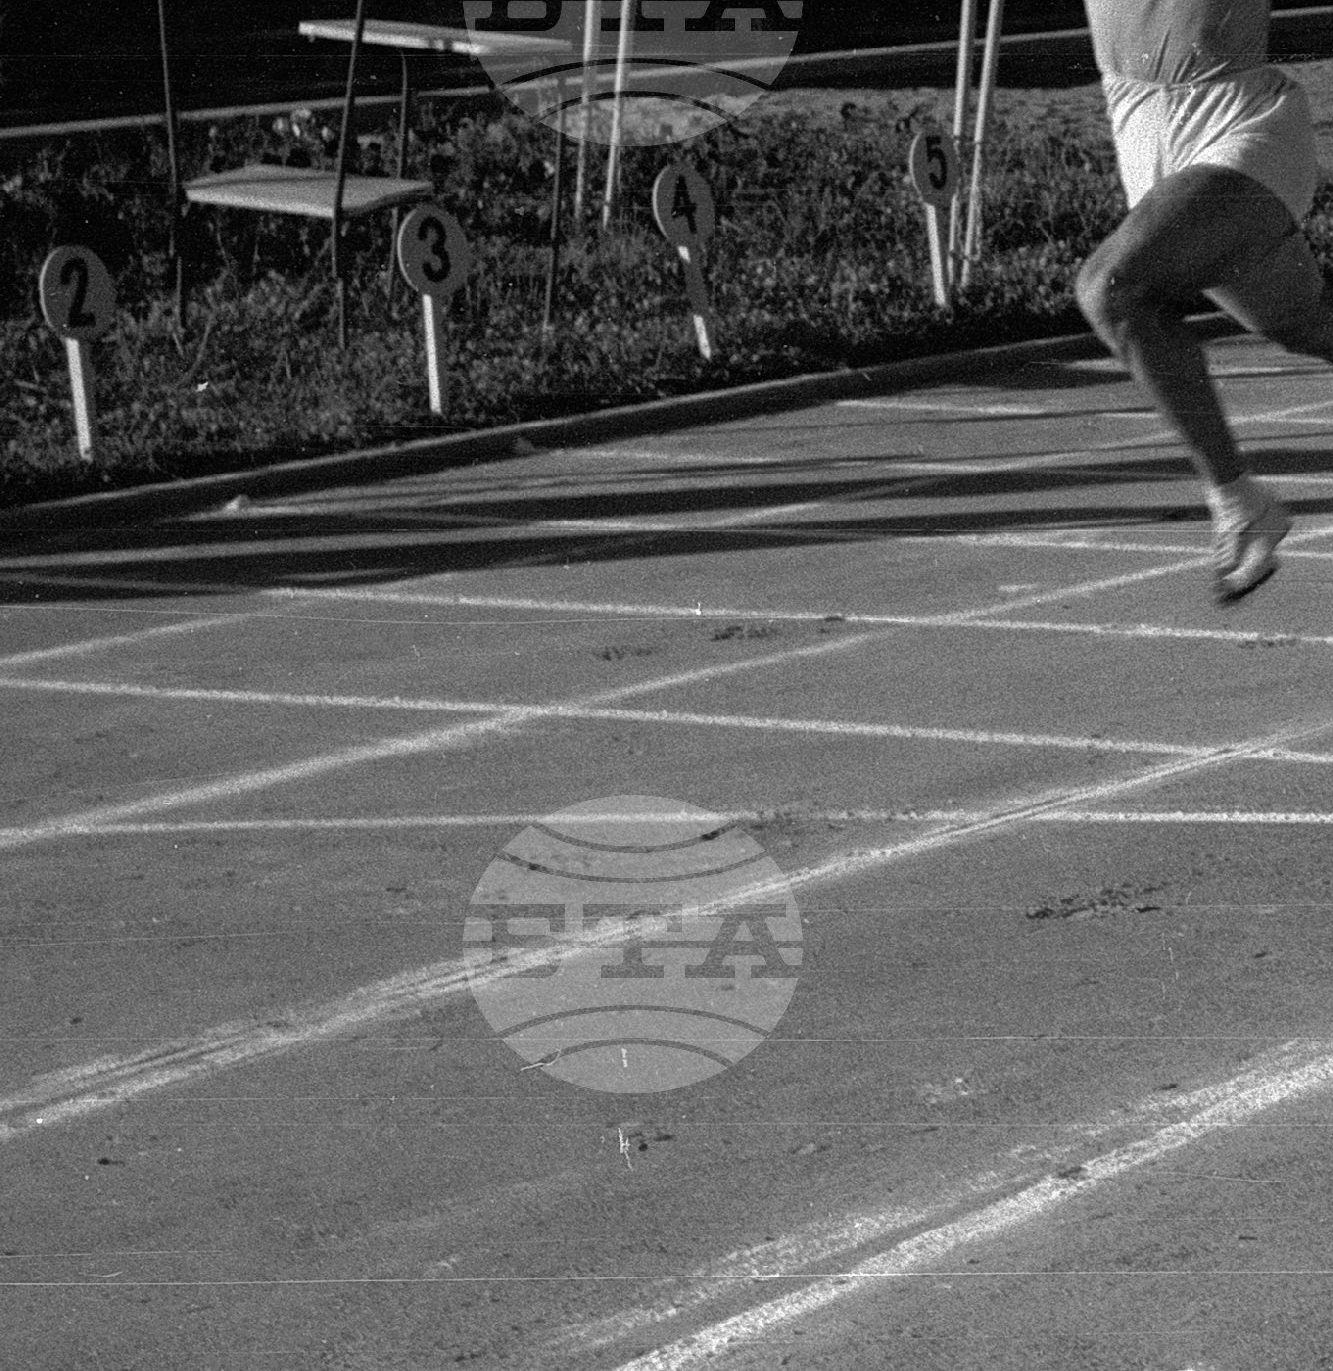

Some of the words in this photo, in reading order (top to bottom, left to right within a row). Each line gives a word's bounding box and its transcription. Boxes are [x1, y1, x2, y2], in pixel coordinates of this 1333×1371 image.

[926, 136, 947, 189] 5
[671, 176, 698, 234] 4
[418, 216, 450, 282] 3
[60, 257, 96, 327] 2
